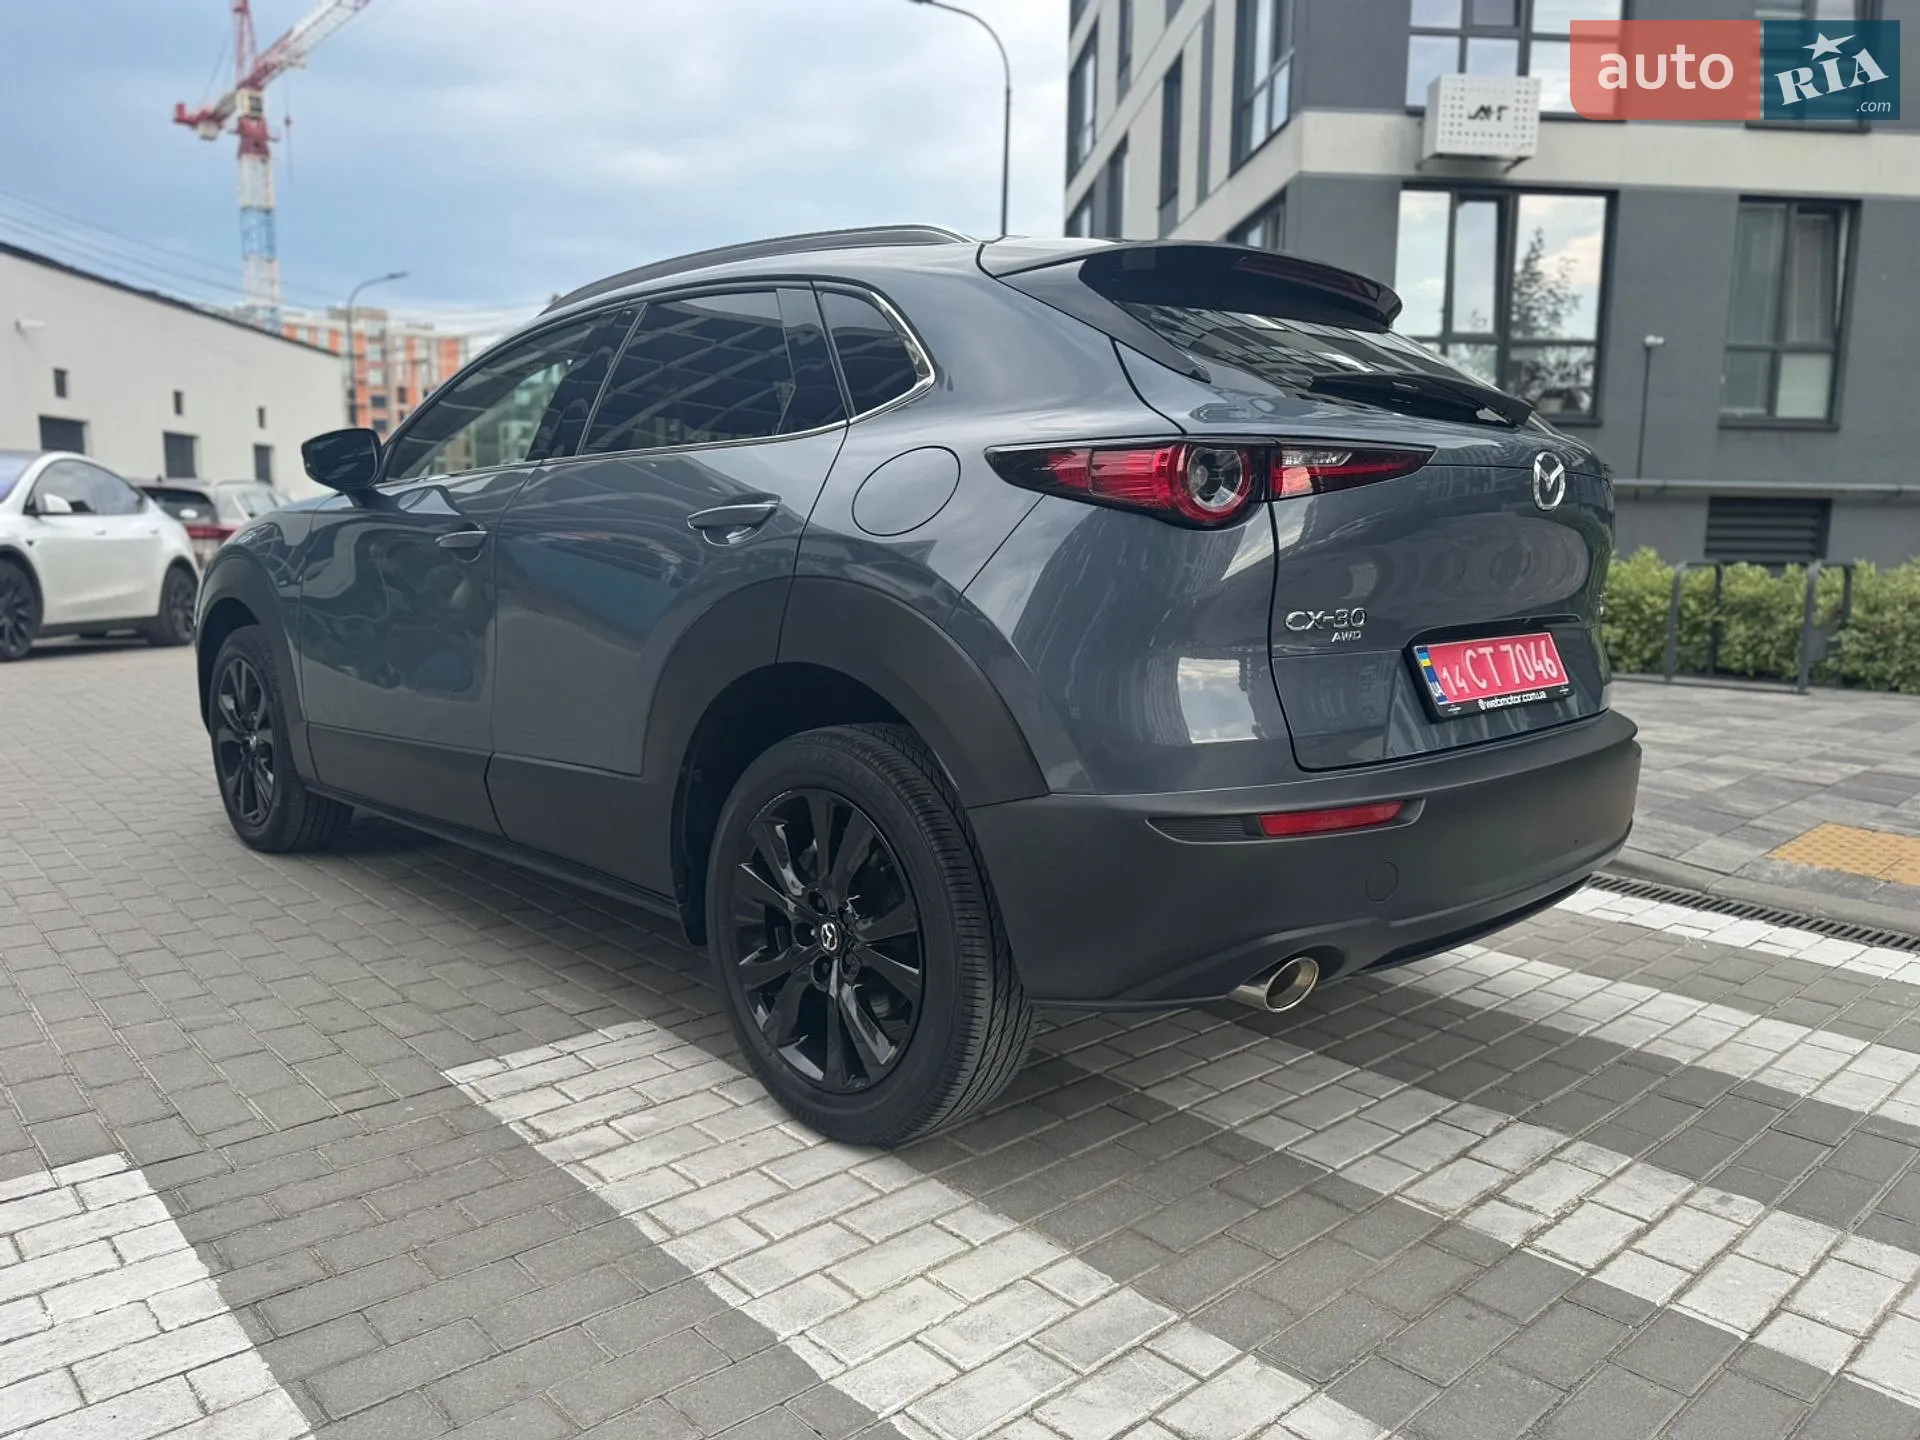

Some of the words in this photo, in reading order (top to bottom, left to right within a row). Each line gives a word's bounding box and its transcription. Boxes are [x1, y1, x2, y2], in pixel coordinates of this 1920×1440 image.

[1285, 607, 1366, 631] CX-30
[1331, 630, 1362, 642] AWD
[1500, 640, 1558, 685] 7046
